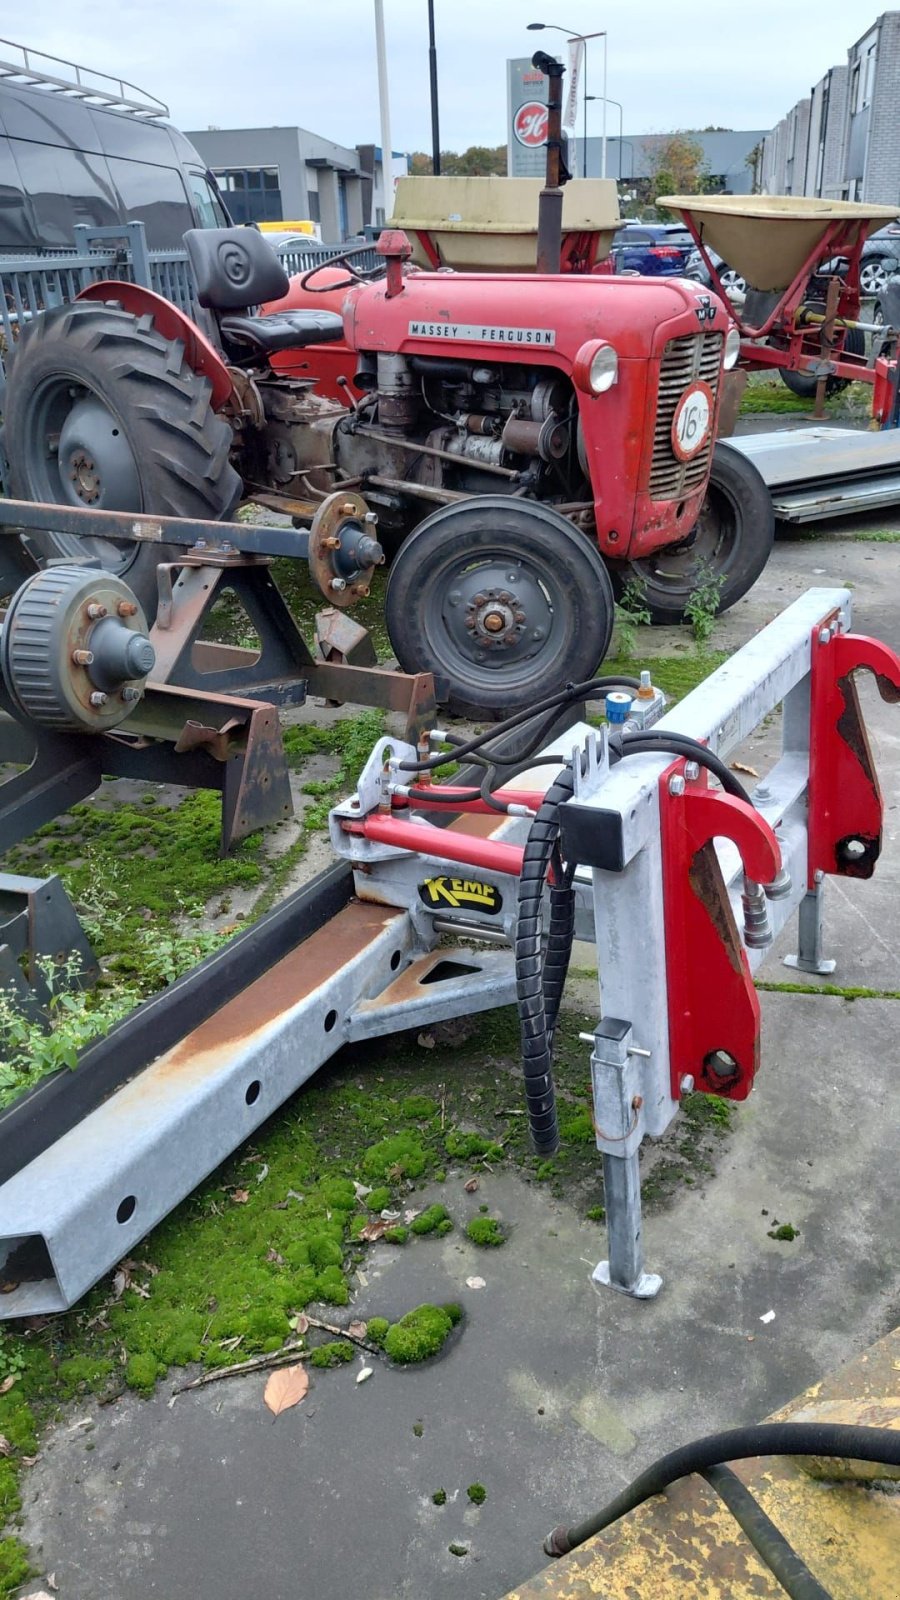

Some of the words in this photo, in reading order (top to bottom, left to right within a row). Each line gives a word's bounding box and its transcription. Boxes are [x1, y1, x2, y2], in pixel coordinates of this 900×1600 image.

[411, 324, 458, 337] MASSEY
[481, 328, 551, 343] FERGUSON
[424, 877, 494, 906] KEMP
